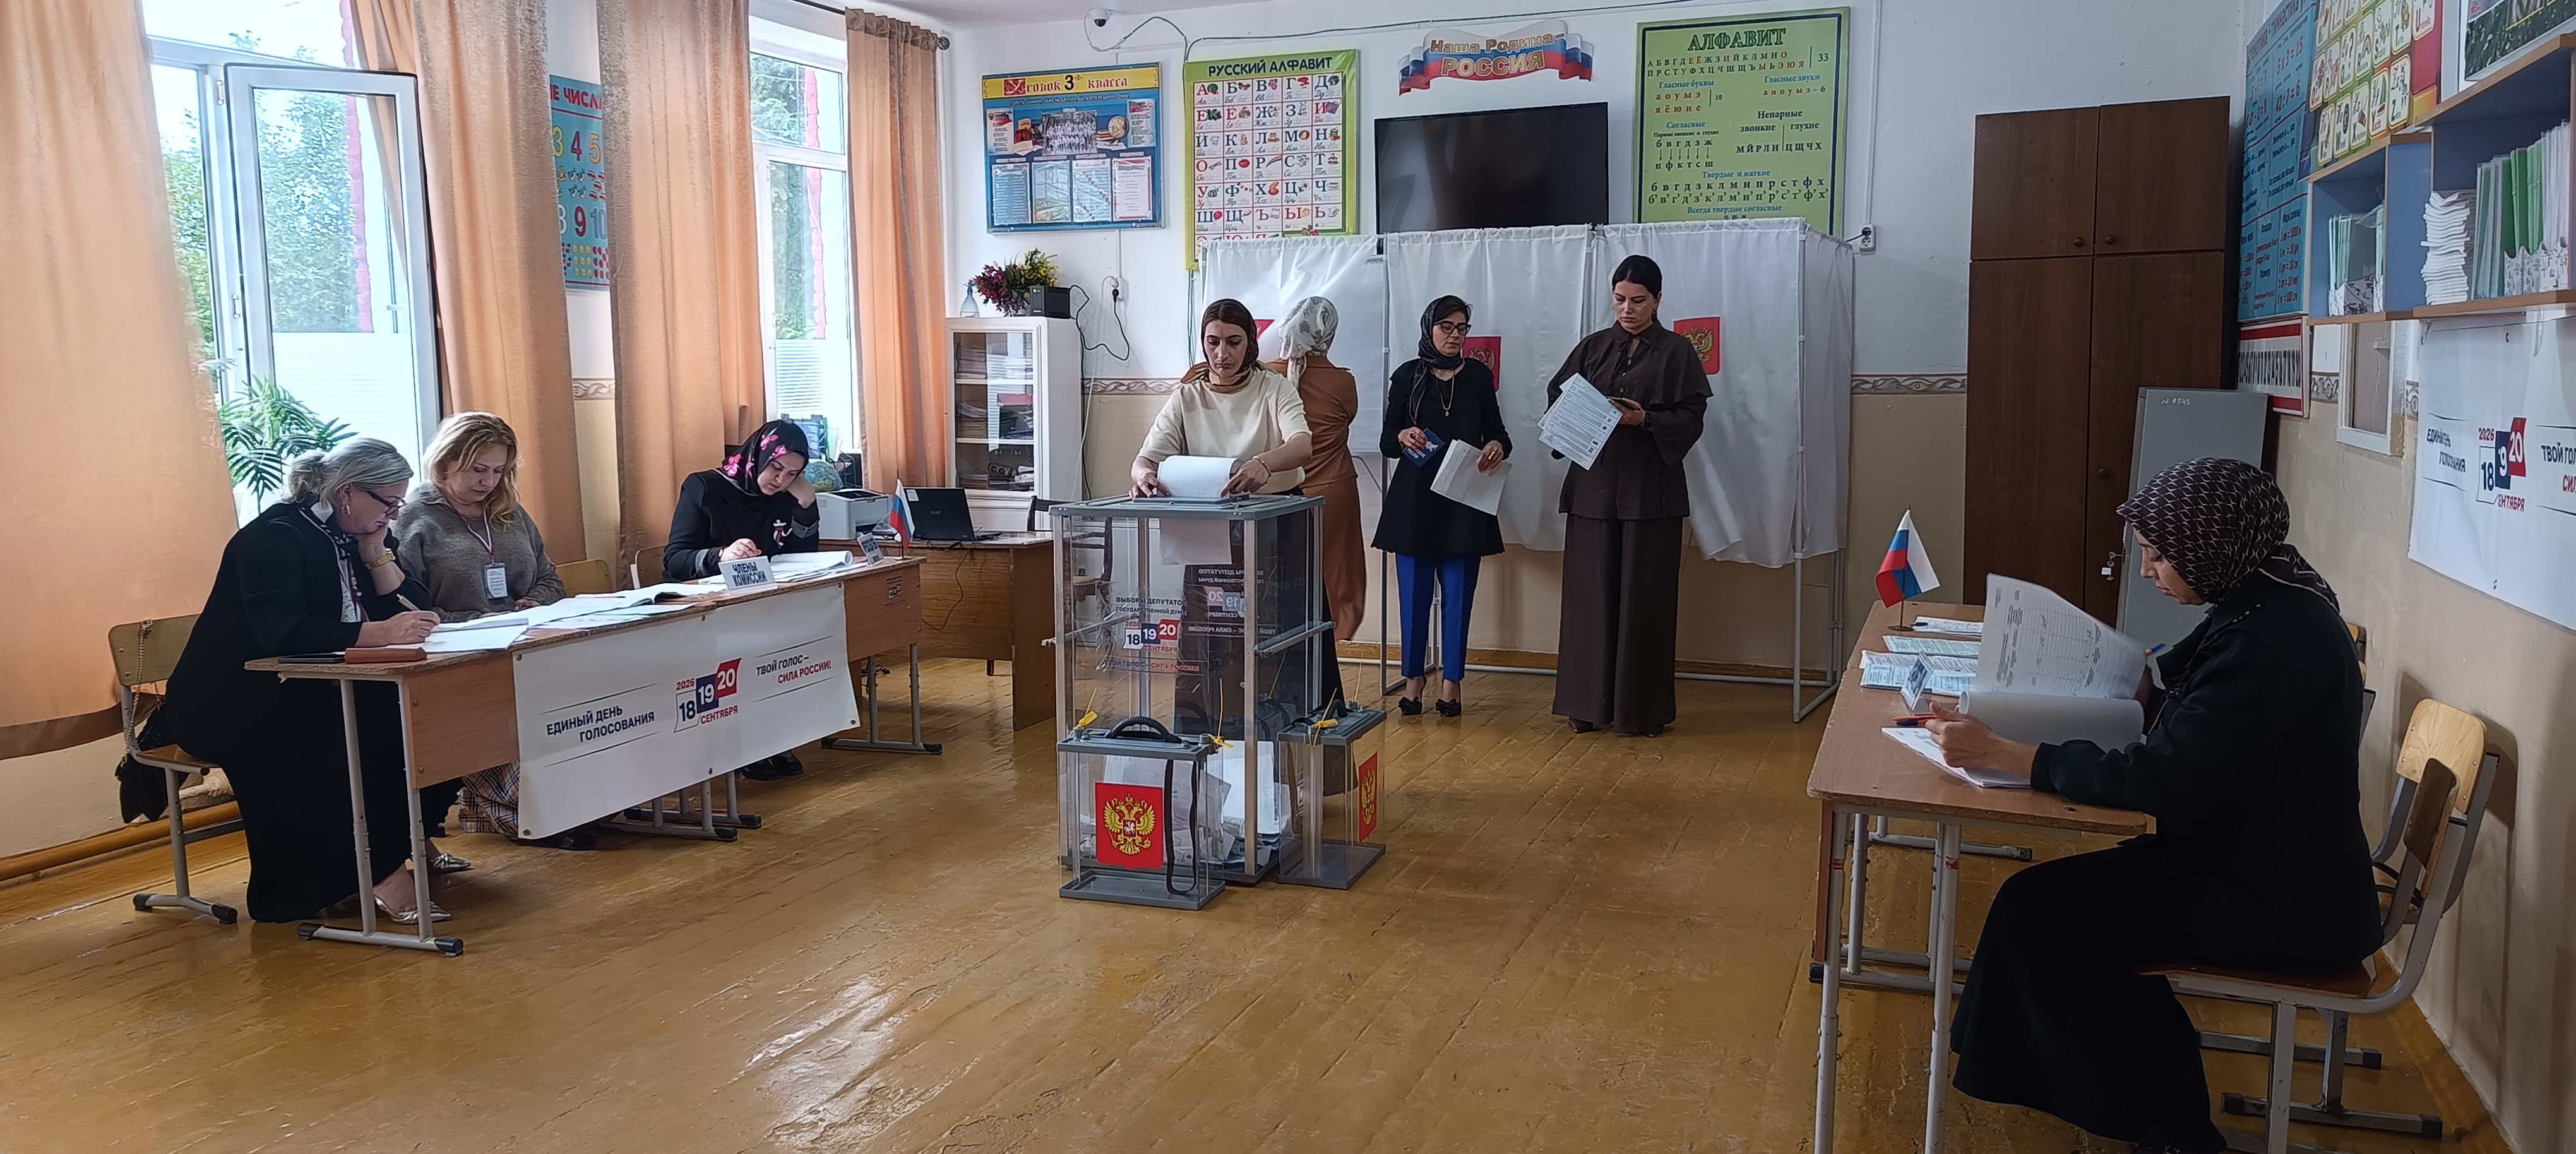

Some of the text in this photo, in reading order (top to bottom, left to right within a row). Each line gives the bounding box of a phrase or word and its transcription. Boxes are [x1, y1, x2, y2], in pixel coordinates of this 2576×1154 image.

[1430, 39, 1481, 54] Наша
[1687, 28, 1786, 51] АЛФАВИТ
[1208, 57, 1332, 77] РУССКИЙ АЛФАВИТ
[1441, 51, 1545, 75] РОССИЯ
[1696, 56, 1702, 64] Ё
[1733, 53, 1739, 61] Й
[1818, 53, 1828, 62] 33
[1064, 75, 1075, 91] 3
[1088, 77, 1128, 89] класса
[1196, 76, 1328, 95] А Б В Г Д
[1691, 80, 1714, 89] буквы
[1797, 74, 1820, 83] звуки
[1197, 102, 1326, 121] Е Ё Ж З И
[1757, 110, 1803, 120] Непарные
[1790, 122, 1820, 132] глухие
[552, 126, 601, 164] 3 4 5
[1196, 128, 1328, 147] Й К Л М Н
[1196, 153, 1325, 172] О П Р С Т
[1702, 171, 1734, 180] Твердые
[1197, 181, 1327, 198] У Ф Х Ц Ч
[575, 206, 587, 237] 9
[590, 208, 607, 239] 10
[1197, 206, 1326, 225] Ш Щ Ъ Ы Ь
[2478, 427, 2495, 441] 2026
[2508, 431, 2523, 463] 20
[2541, 442, 2563, 463] ТВОЙ
[2481, 461, 2495, 491] 18
[2498, 494, 2525, 512] ЕНТЯБРЯ
[732, 561, 758, 574] ЧЛЕНЫ
[732, 570, 768, 587] КОМИССИИ
[1127, 634, 1140, 645] 18
[1143, 628, 1157, 640] 19
[1159, 624, 1176, 636] 20
[756, 660, 777, 676] ТВОЙ
[778, 655, 803, 670] ГОЛОС
[778, 660, 832, 684] СИЛА РОССИИ!
[676, 678, 695, 691] 2026
[717, 668, 736, 691] 20
[698, 684, 715, 705] 19
[546, 705, 623, 736] ЕДИНЫЙ ДЕНЬ
[679, 700, 696, 722] 18
[701, 705, 738, 724] СЕНТЯБРЯ
[579, 711, 655, 743] ГОЛОСОВАНИЯ
